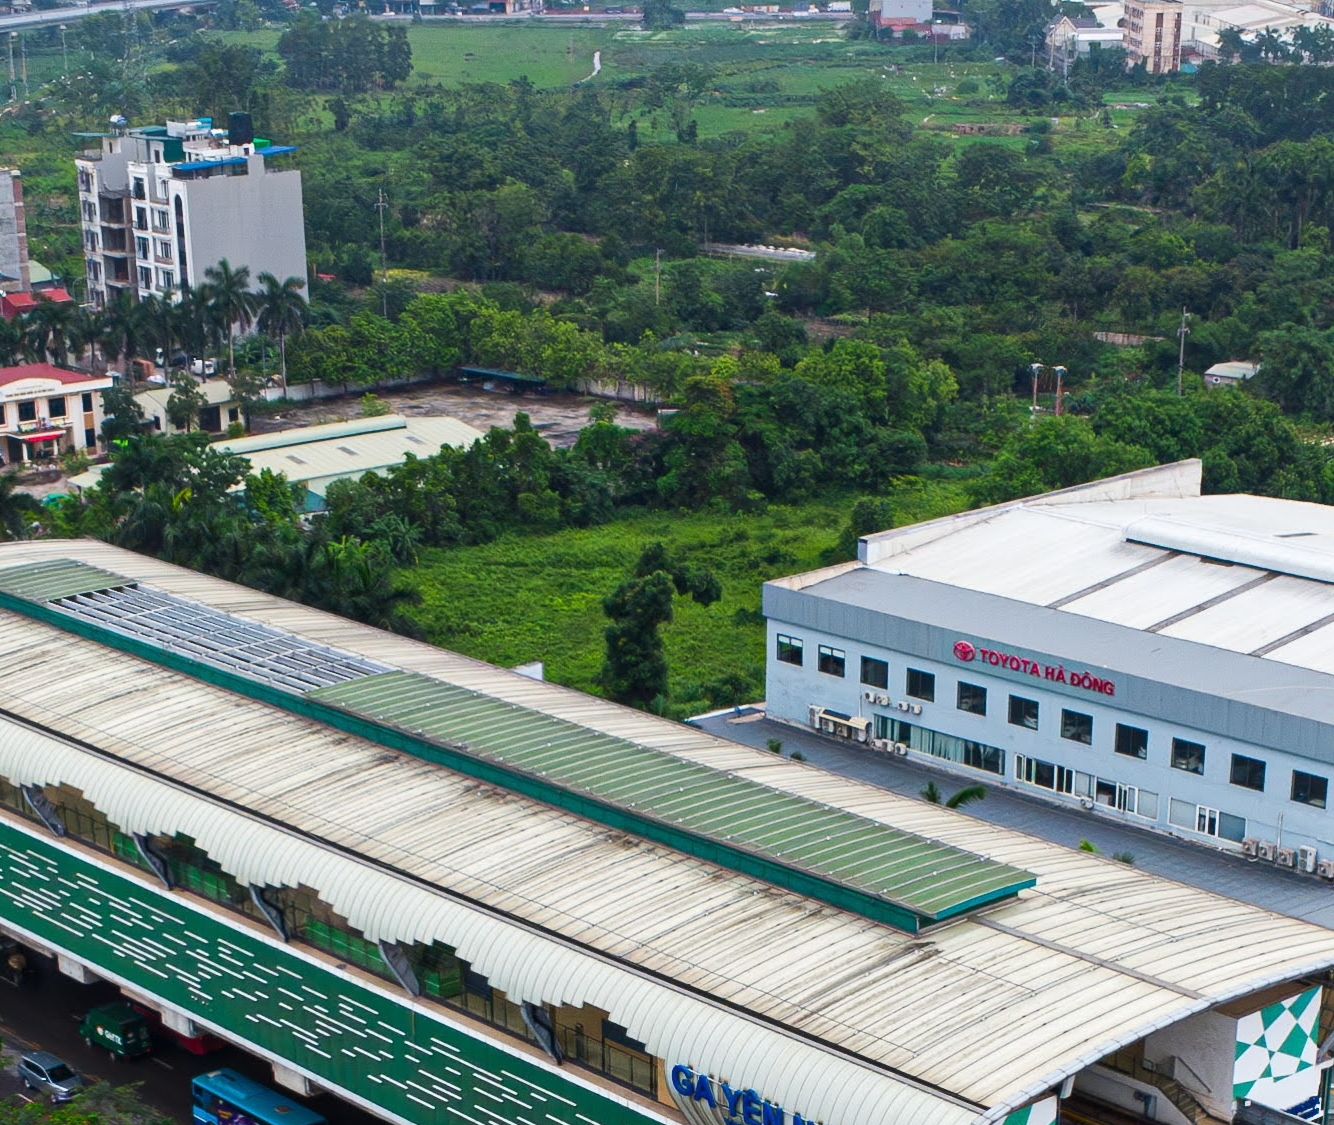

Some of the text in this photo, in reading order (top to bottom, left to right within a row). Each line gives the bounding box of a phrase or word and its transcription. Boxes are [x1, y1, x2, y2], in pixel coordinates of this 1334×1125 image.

[979, 647, 1115, 696] TOYOTA HÀ ĐÔNG
[672, 1064, 716, 1109] GA
